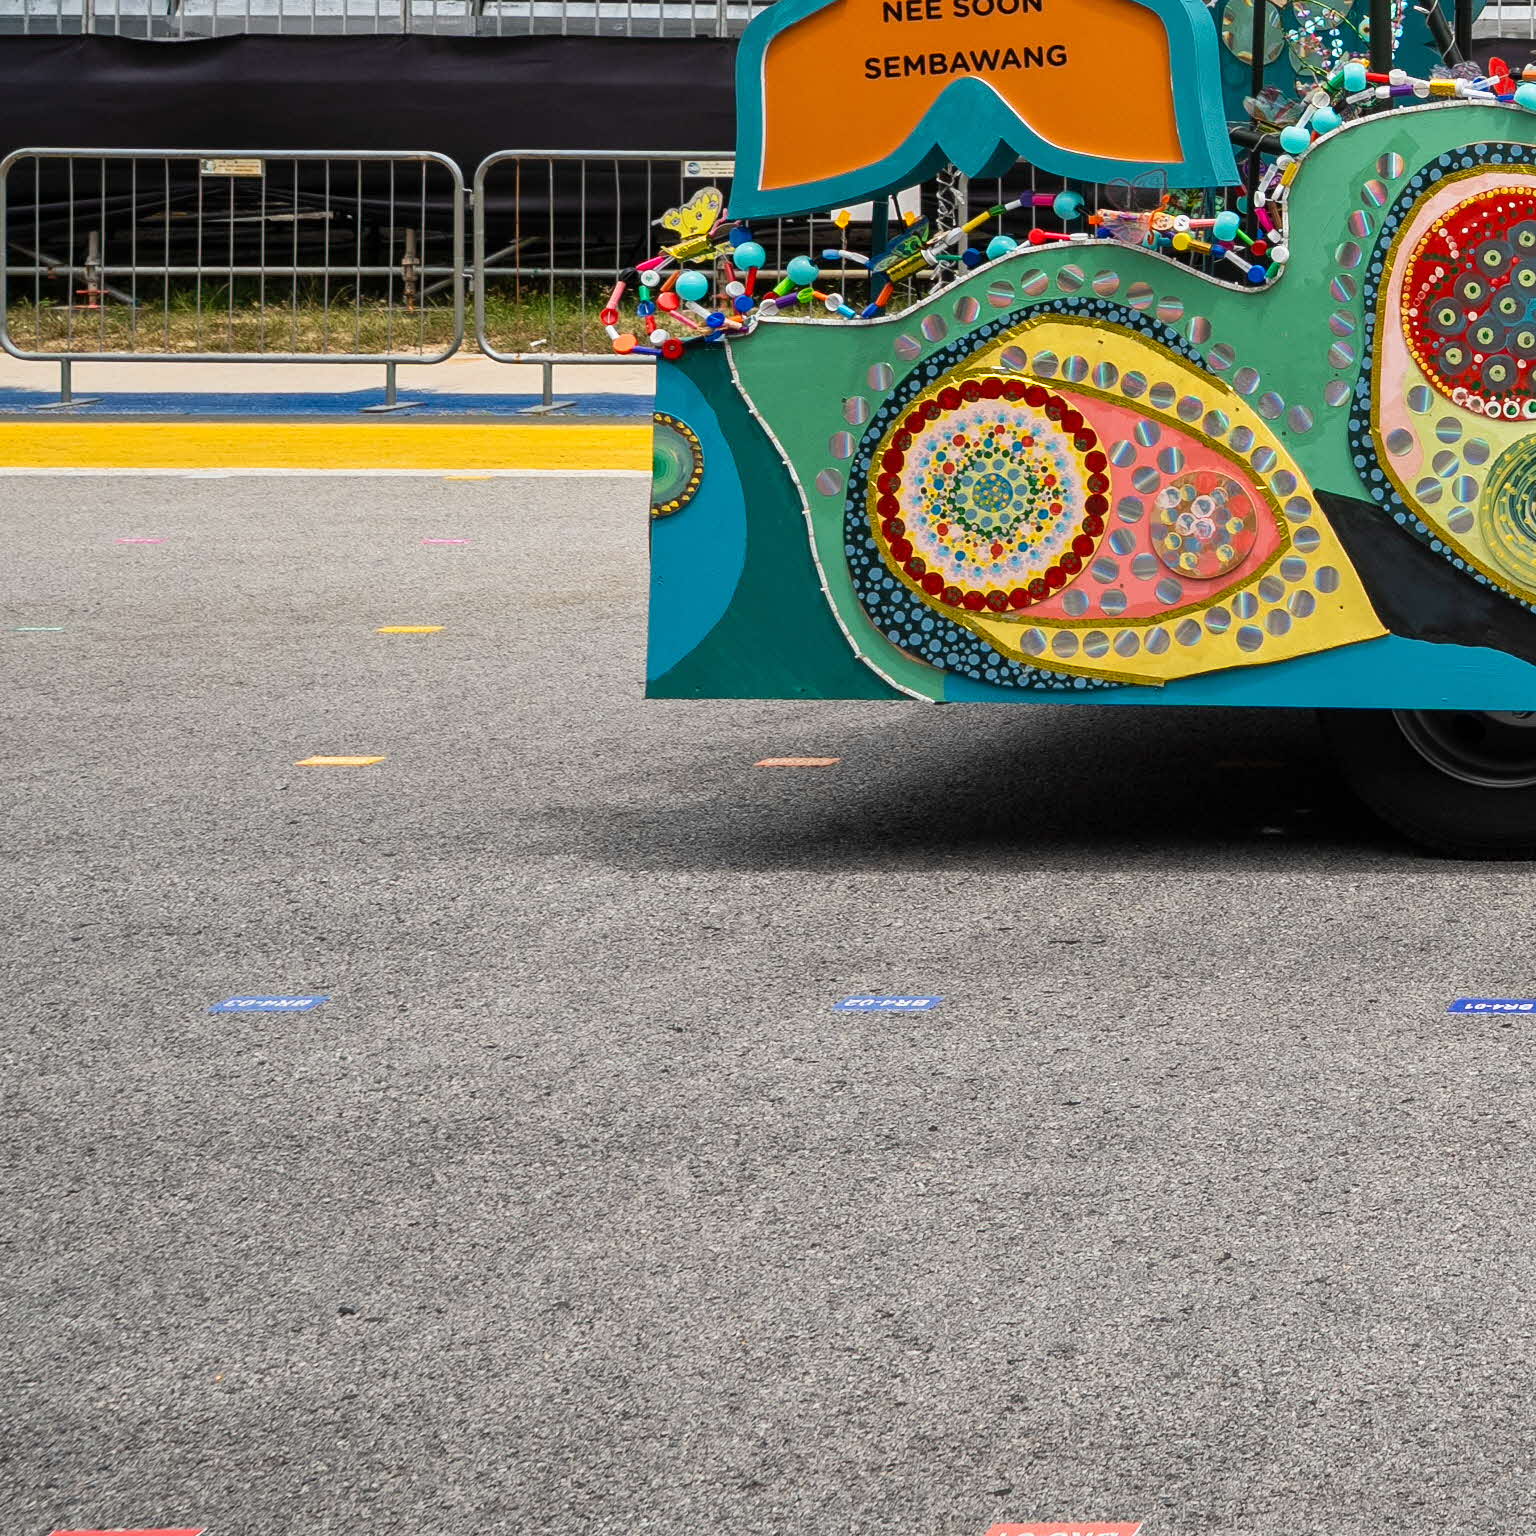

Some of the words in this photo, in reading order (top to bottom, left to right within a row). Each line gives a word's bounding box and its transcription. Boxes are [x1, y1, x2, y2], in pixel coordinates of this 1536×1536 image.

[864, 44, 1068, 80] SEMBAWANG
[844, 999, 930, 1007] BR4-02
[1464, 1003, 1534, 1011] BR4-01
